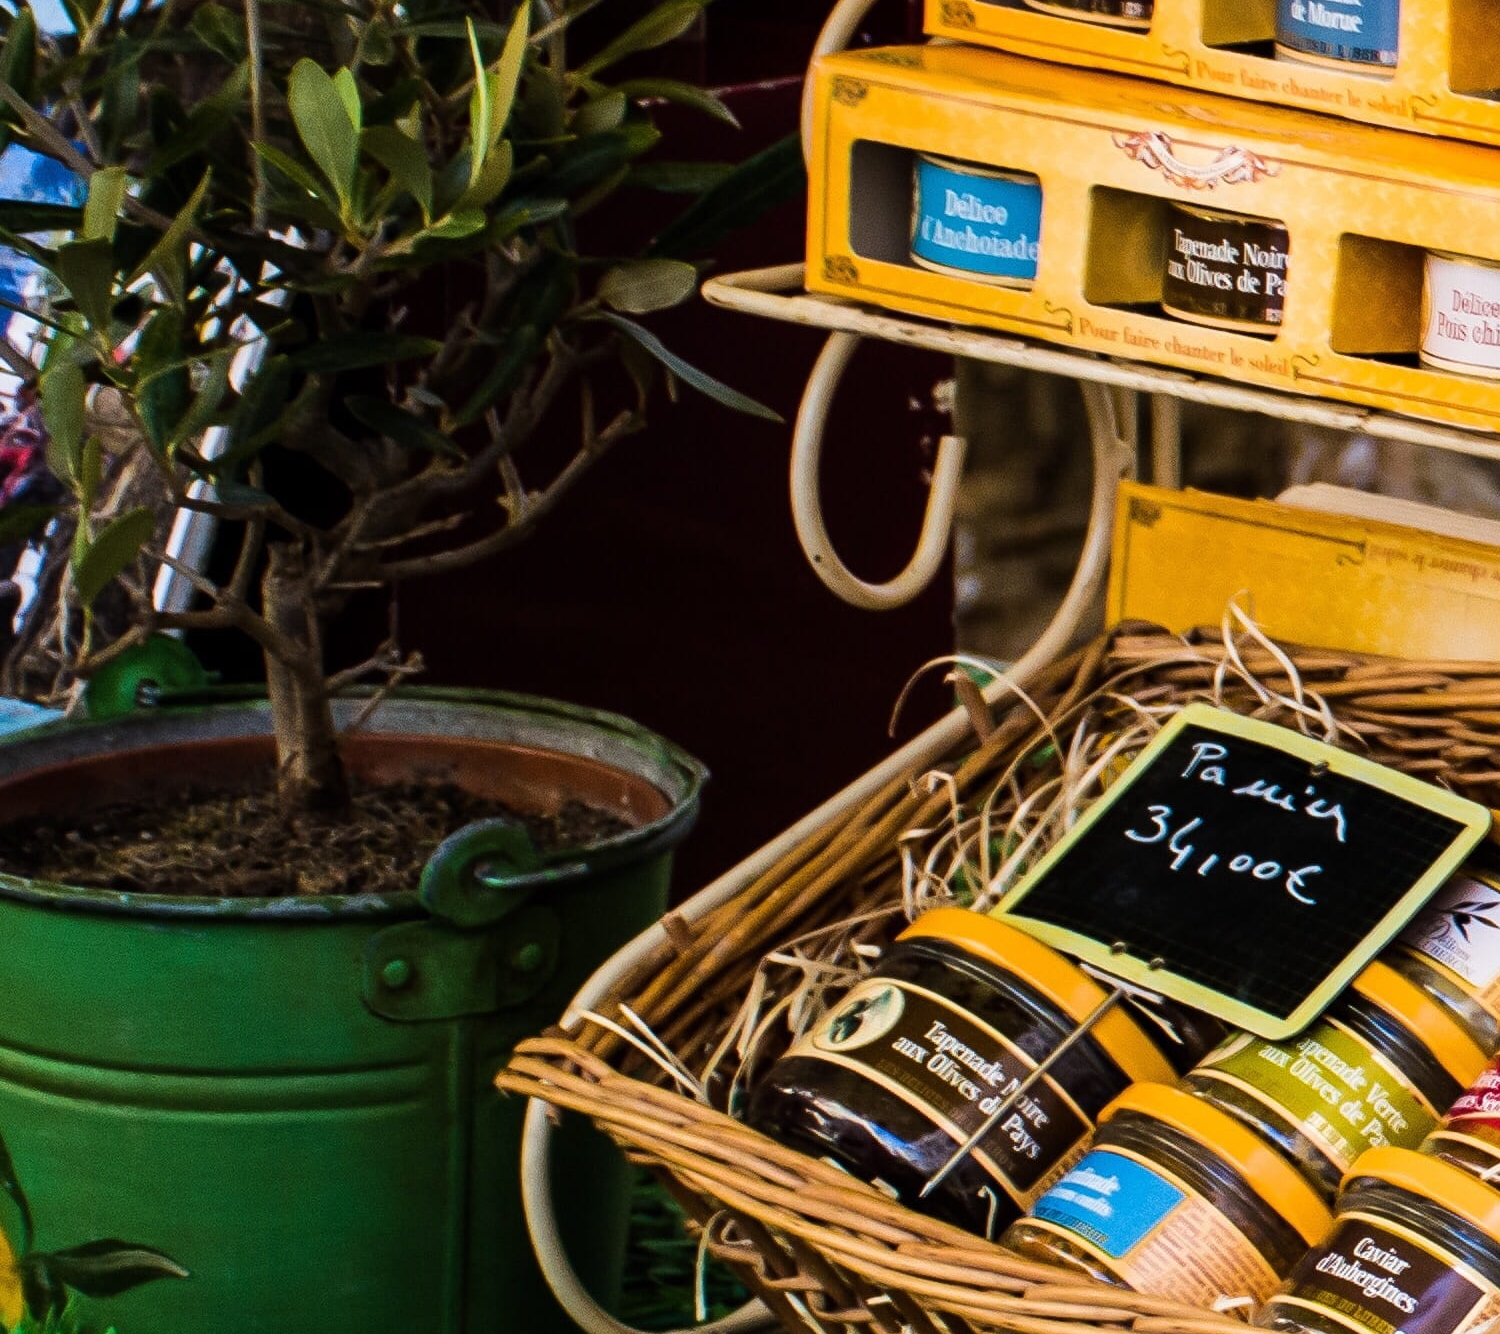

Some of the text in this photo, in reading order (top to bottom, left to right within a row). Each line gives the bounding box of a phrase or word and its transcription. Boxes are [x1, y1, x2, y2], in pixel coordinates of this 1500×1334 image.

[1308, 4, 1362, 33] Morue
[945, 189, 1008, 226] Délice
[1186, 260, 1260, 295] Olives de
[1079, 318, 1289, 377] Pour faire chanter le soleil
[1182, 742, 1347, 842] Panier
[1124, 805, 1323, 905] 34,00€
[923, 1020, 1007, 1084] Tapenade
[892, 1034, 1042, 1160] aux Olives Pays
[1316, 1253, 1419, 1313] d'Aubergines
[1354, 1238, 1411, 1275] Caviar
